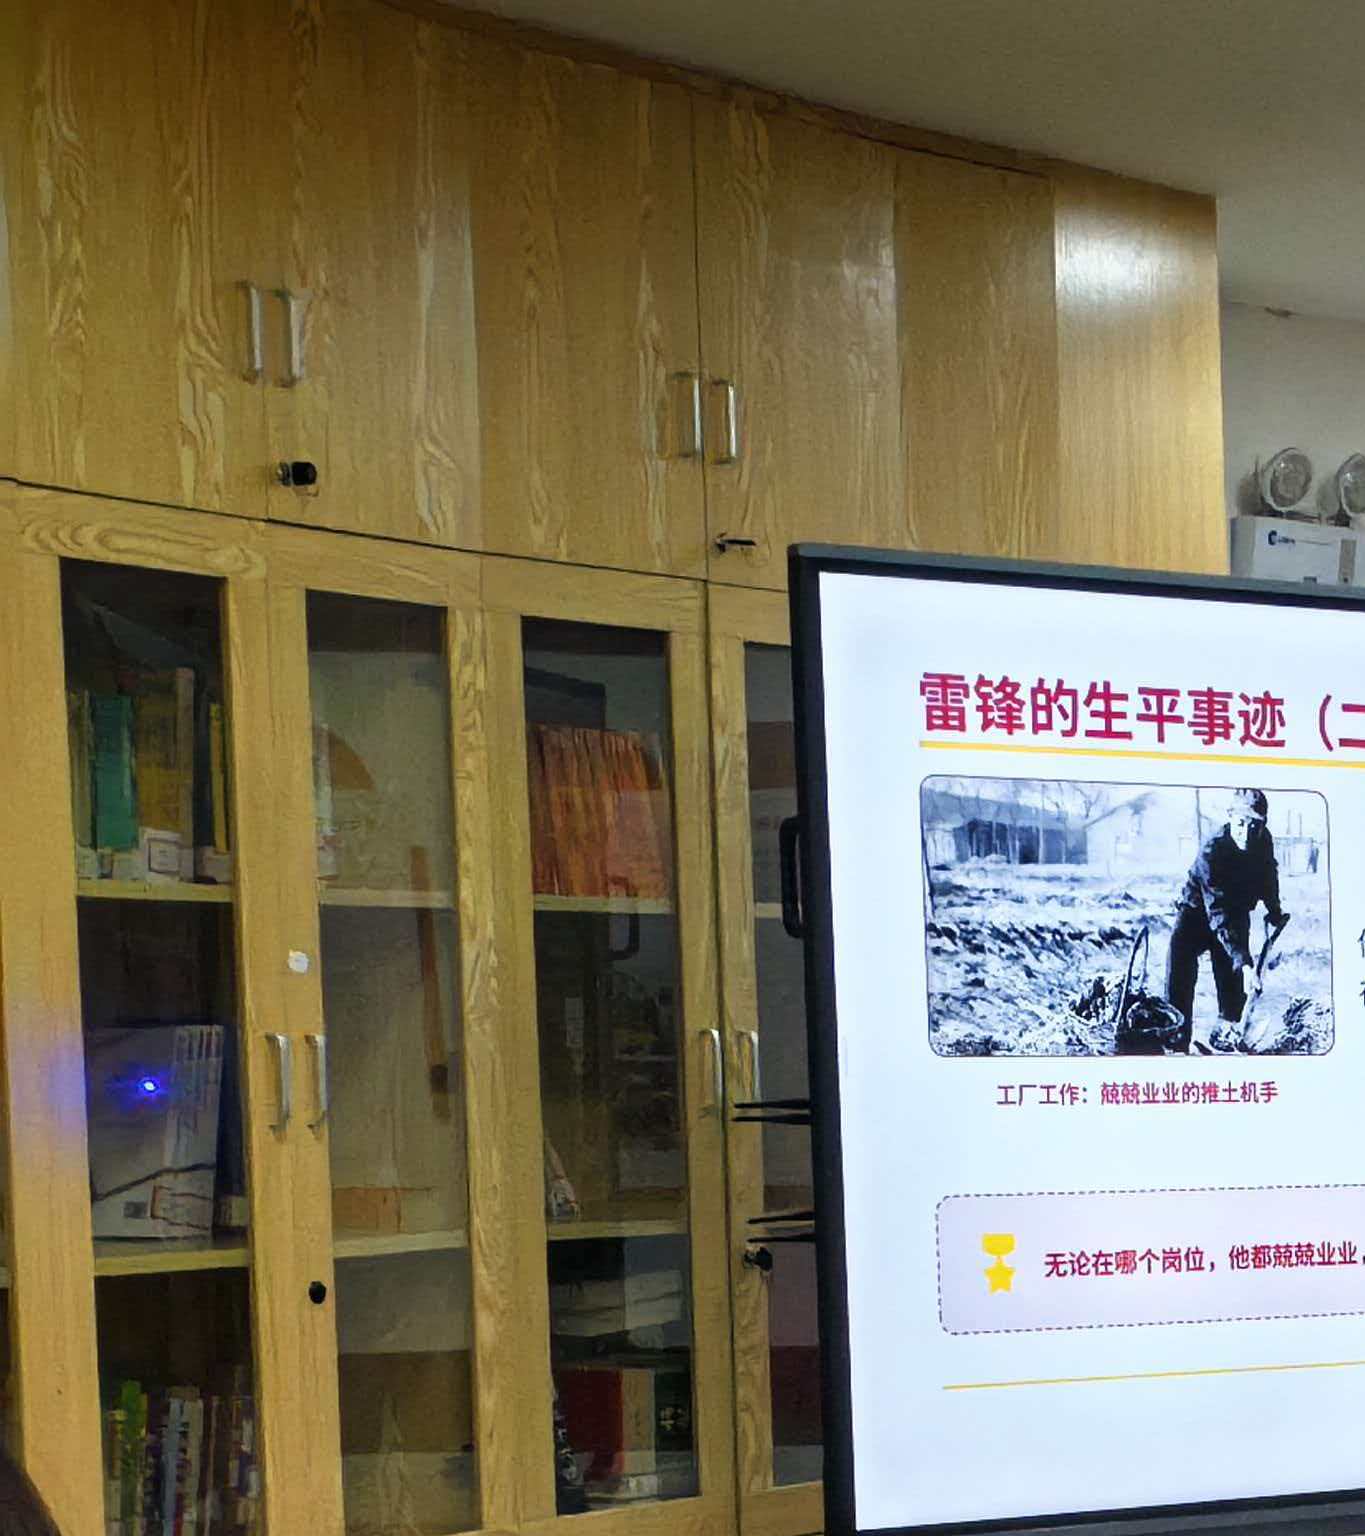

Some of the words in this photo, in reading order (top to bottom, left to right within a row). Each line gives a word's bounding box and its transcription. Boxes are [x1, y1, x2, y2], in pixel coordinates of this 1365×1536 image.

[997, 1080, 1279, 1107] 工厂工作：兢兢业业的推土机手
